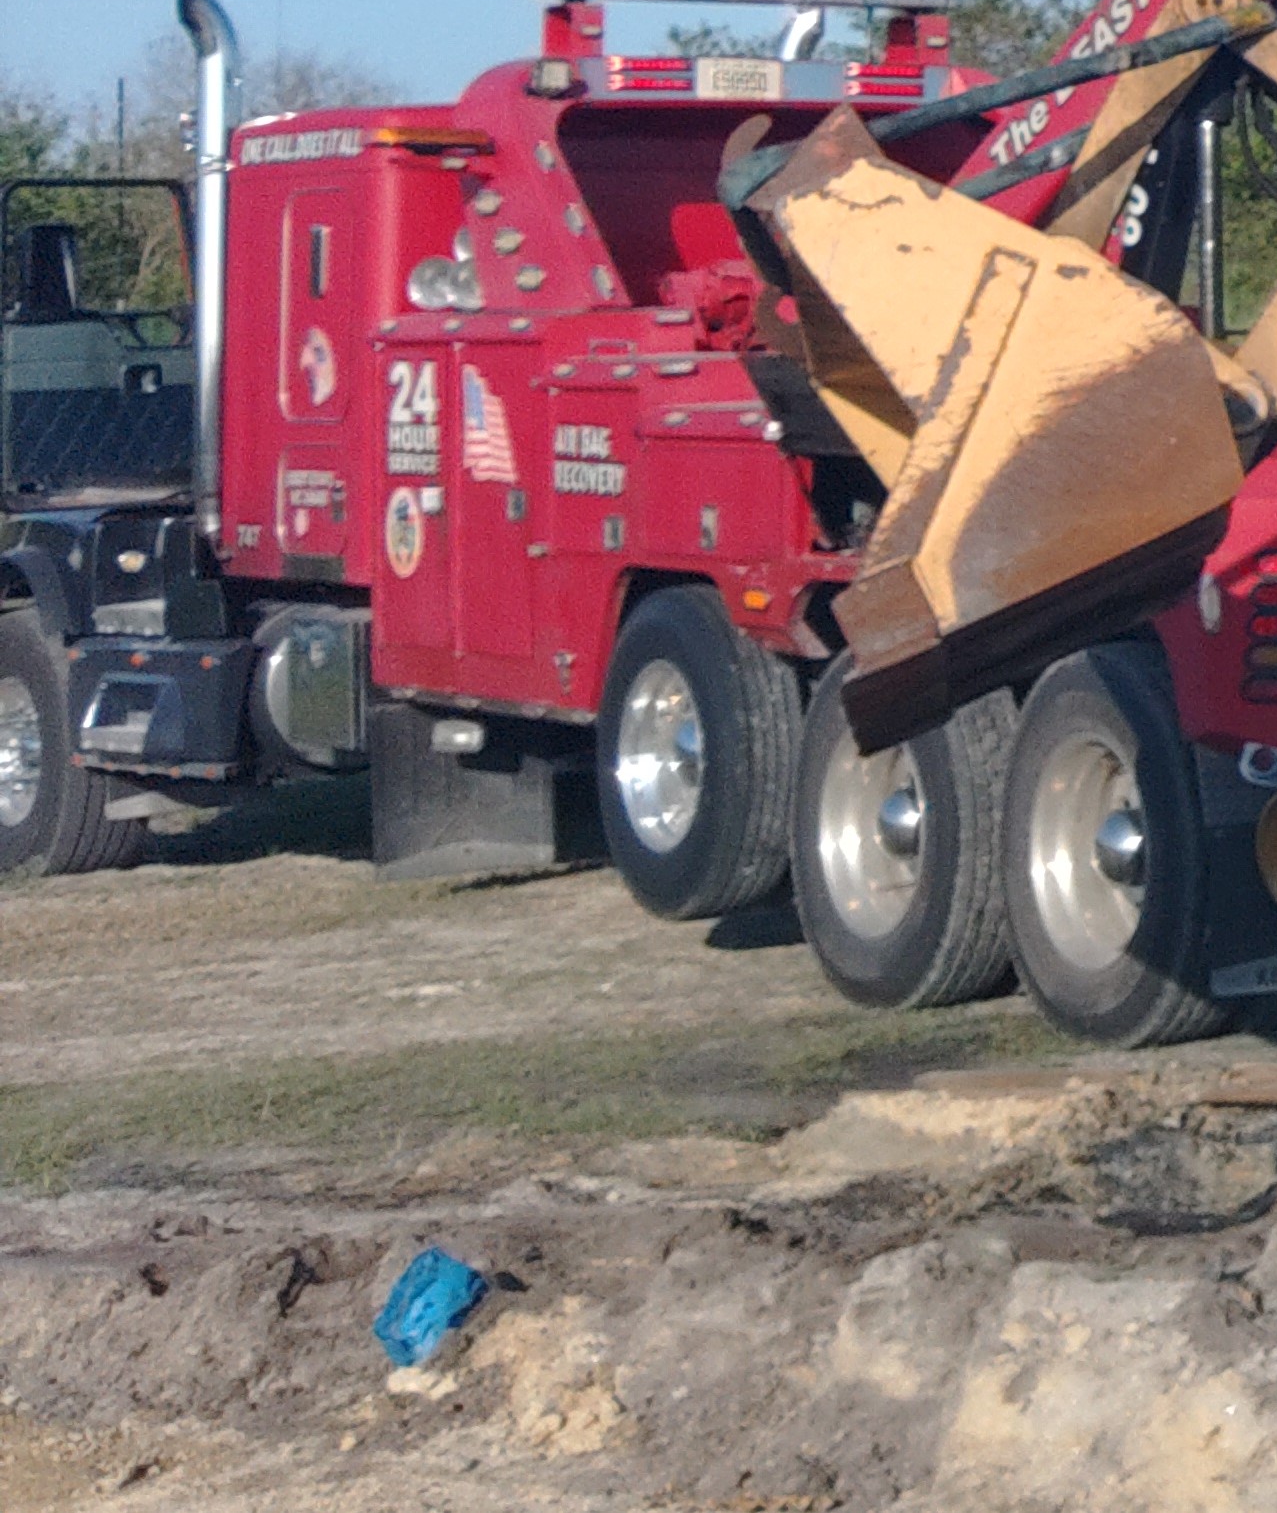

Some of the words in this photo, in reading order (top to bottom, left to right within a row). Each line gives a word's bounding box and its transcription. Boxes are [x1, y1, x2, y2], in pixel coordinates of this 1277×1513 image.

[989, 99, 1048, 166] The
[389, 360, 438, 424] 24
[388, 424, 440, 452] HOUR
[555, 424, 578, 456] AIR
[580, 425, 612, 459] BAG
[388, 452, 441, 476] SERVICE
[554, 460, 626, 497] RECOVERY
